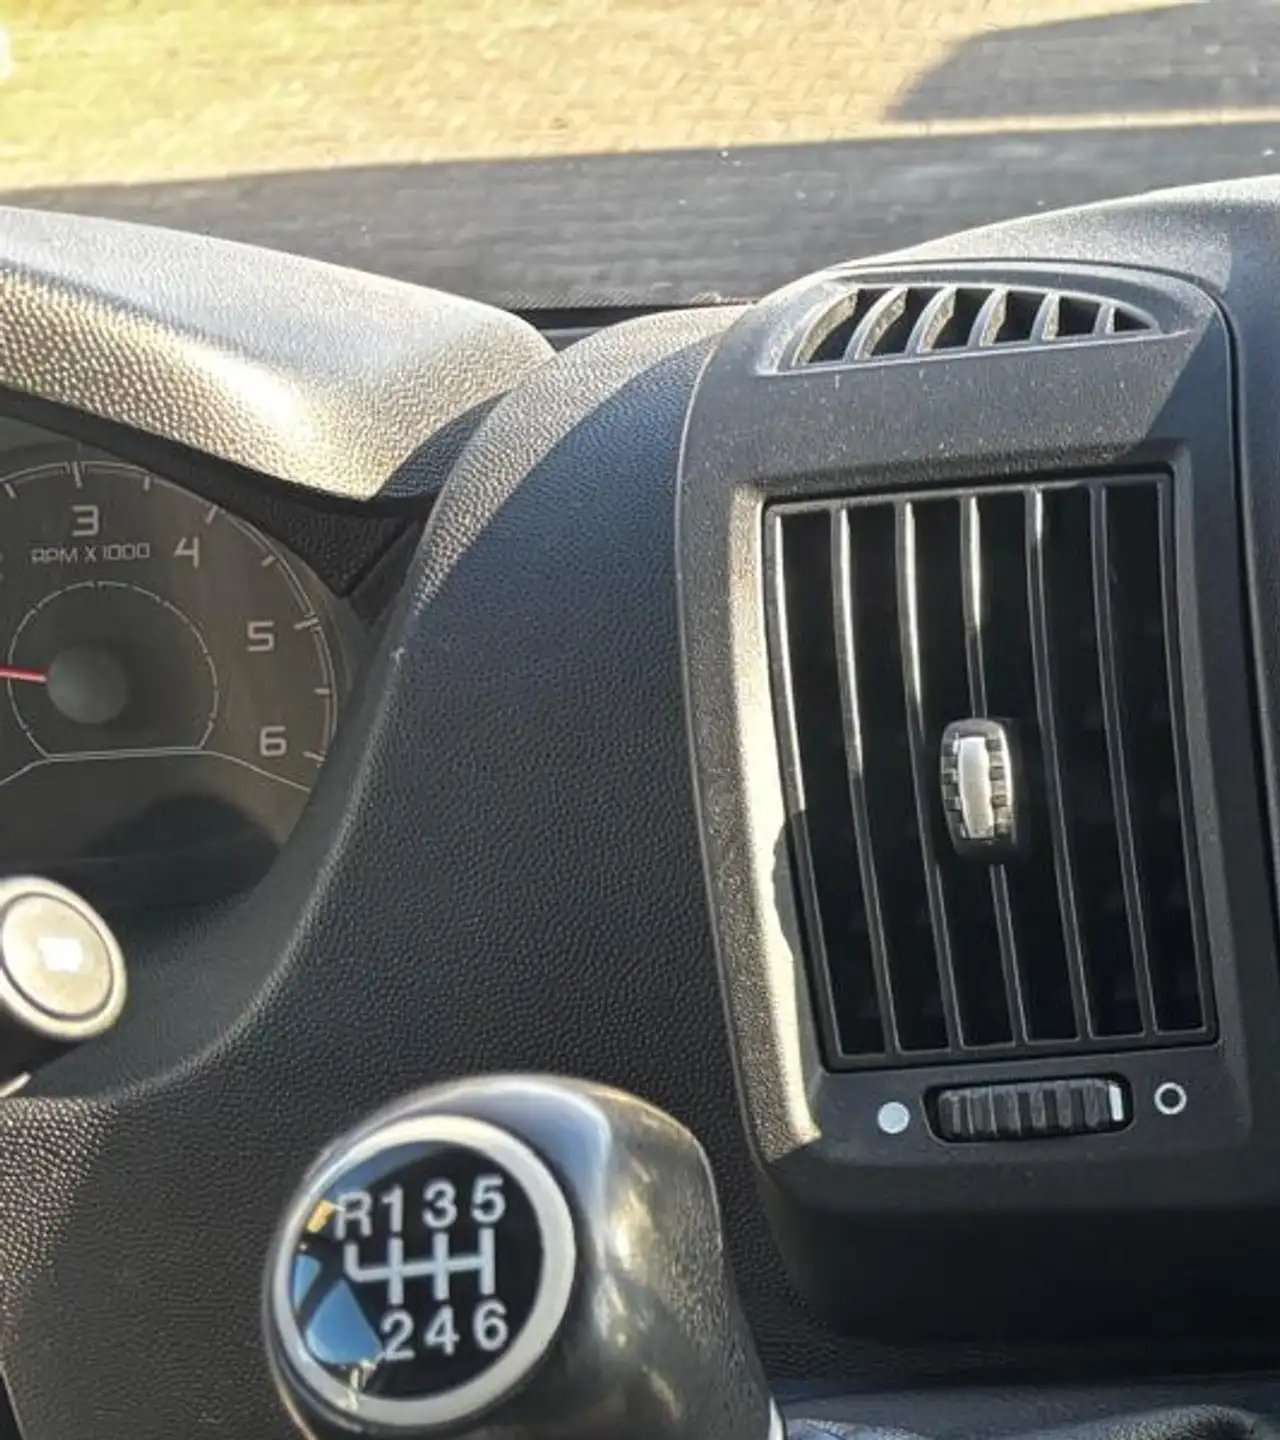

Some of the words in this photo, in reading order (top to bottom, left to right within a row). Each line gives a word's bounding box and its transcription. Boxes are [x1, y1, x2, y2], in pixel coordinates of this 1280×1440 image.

[71, 504, 100, 537] 3
[30, 547, 78, 565] RPM
[102, 541, 151, 562] 1000
[173, 536, 201, 570] 4
[246, 619, 276, 653] 5
[258, 724, 288, 758] 6
[335, 1191, 372, 1239] R
[380, 1184, 404, 1233] 1
[421, 1178, 457, 1229] 3
[470, 1174, 507, 1224] 5
[380, 1310, 415, 1362] 2
[423, 1305, 460, 1356] 4
[472, 1301, 509, 1351] 6
